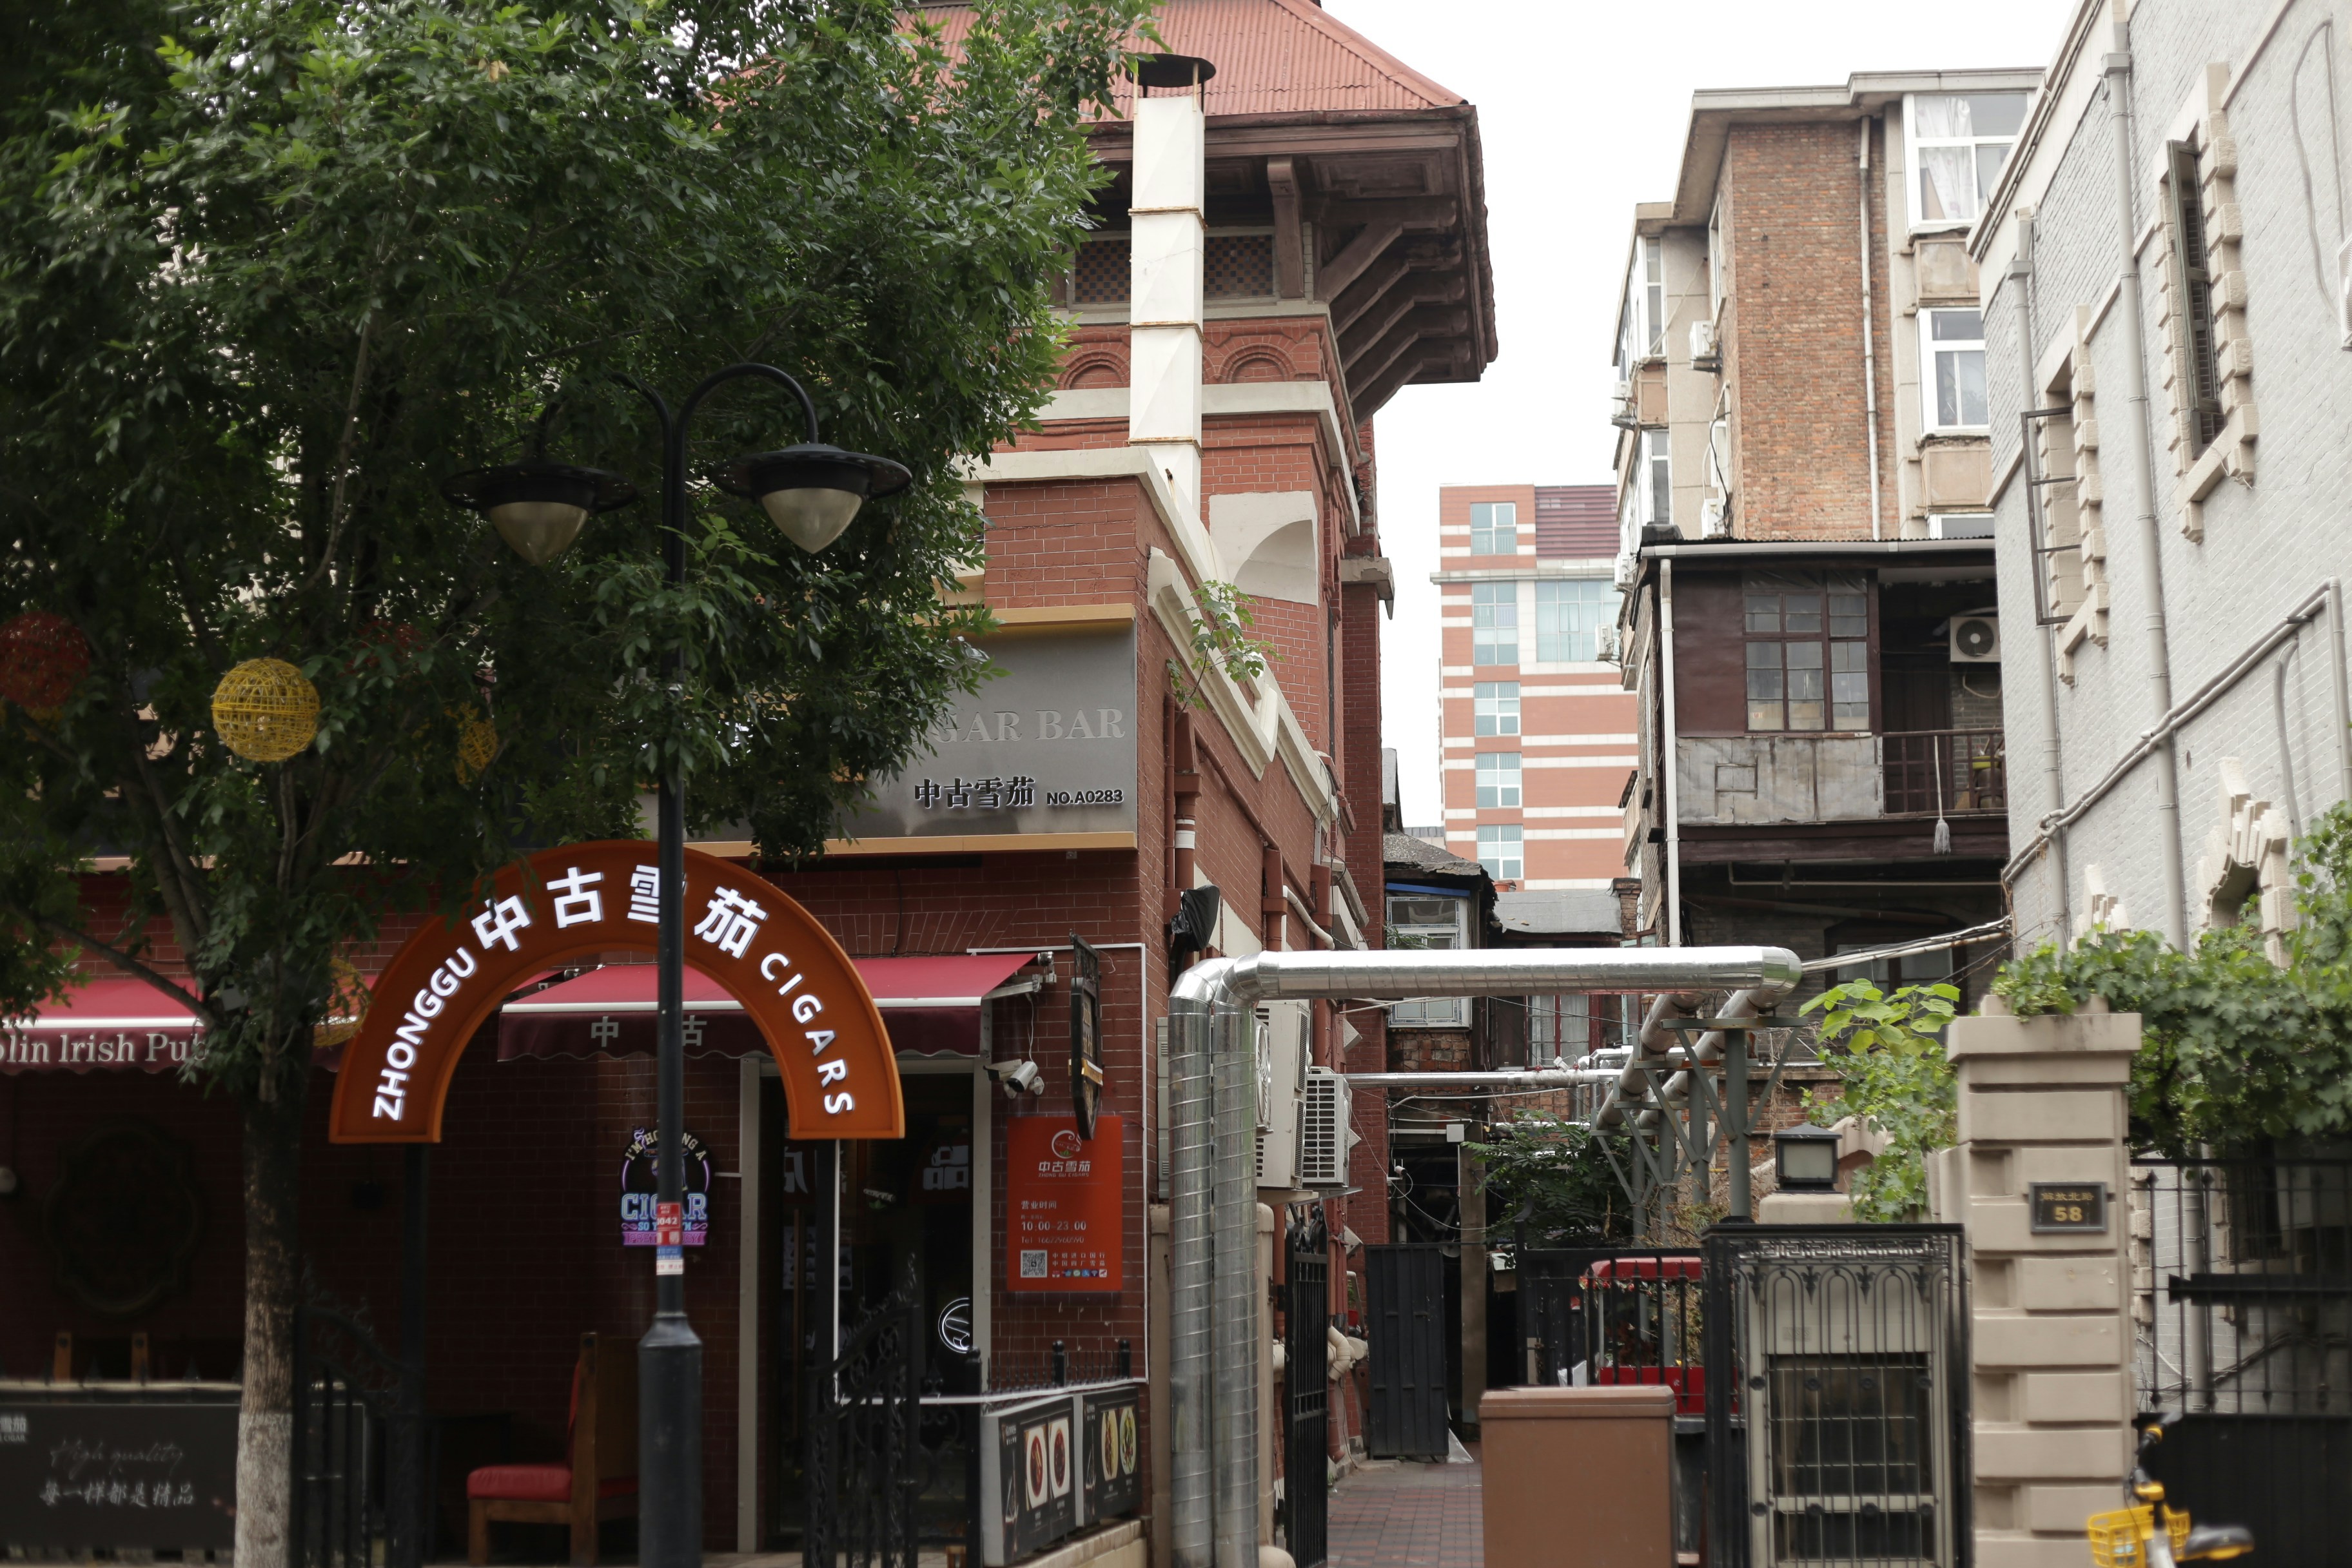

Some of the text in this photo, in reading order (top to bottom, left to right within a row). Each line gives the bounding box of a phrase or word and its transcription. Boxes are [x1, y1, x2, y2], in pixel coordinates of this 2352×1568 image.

[913, 707, 1126, 743] GAR BAR
[914, 776, 1124, 810] 中古雪茄 NO.A0283
[58, 1033, 135, 1063] Irish
[145, 1032, 210, 1063] Pub
[372, 946, 478, 1122] ZHONGGU
[760, 951, 856, 1116] CIGARS
[645, 1130, 699, 1149] HONG
[695, 1149, 707, 1162] A
[1038, 1161, 1091, 1172] 中古雪茄
[1021, 1200, 1057, 1210] 营业时间
[2041, 1191, 2095, 1201] 解放北路
[2054, 1206, 2083, 1222] 58
